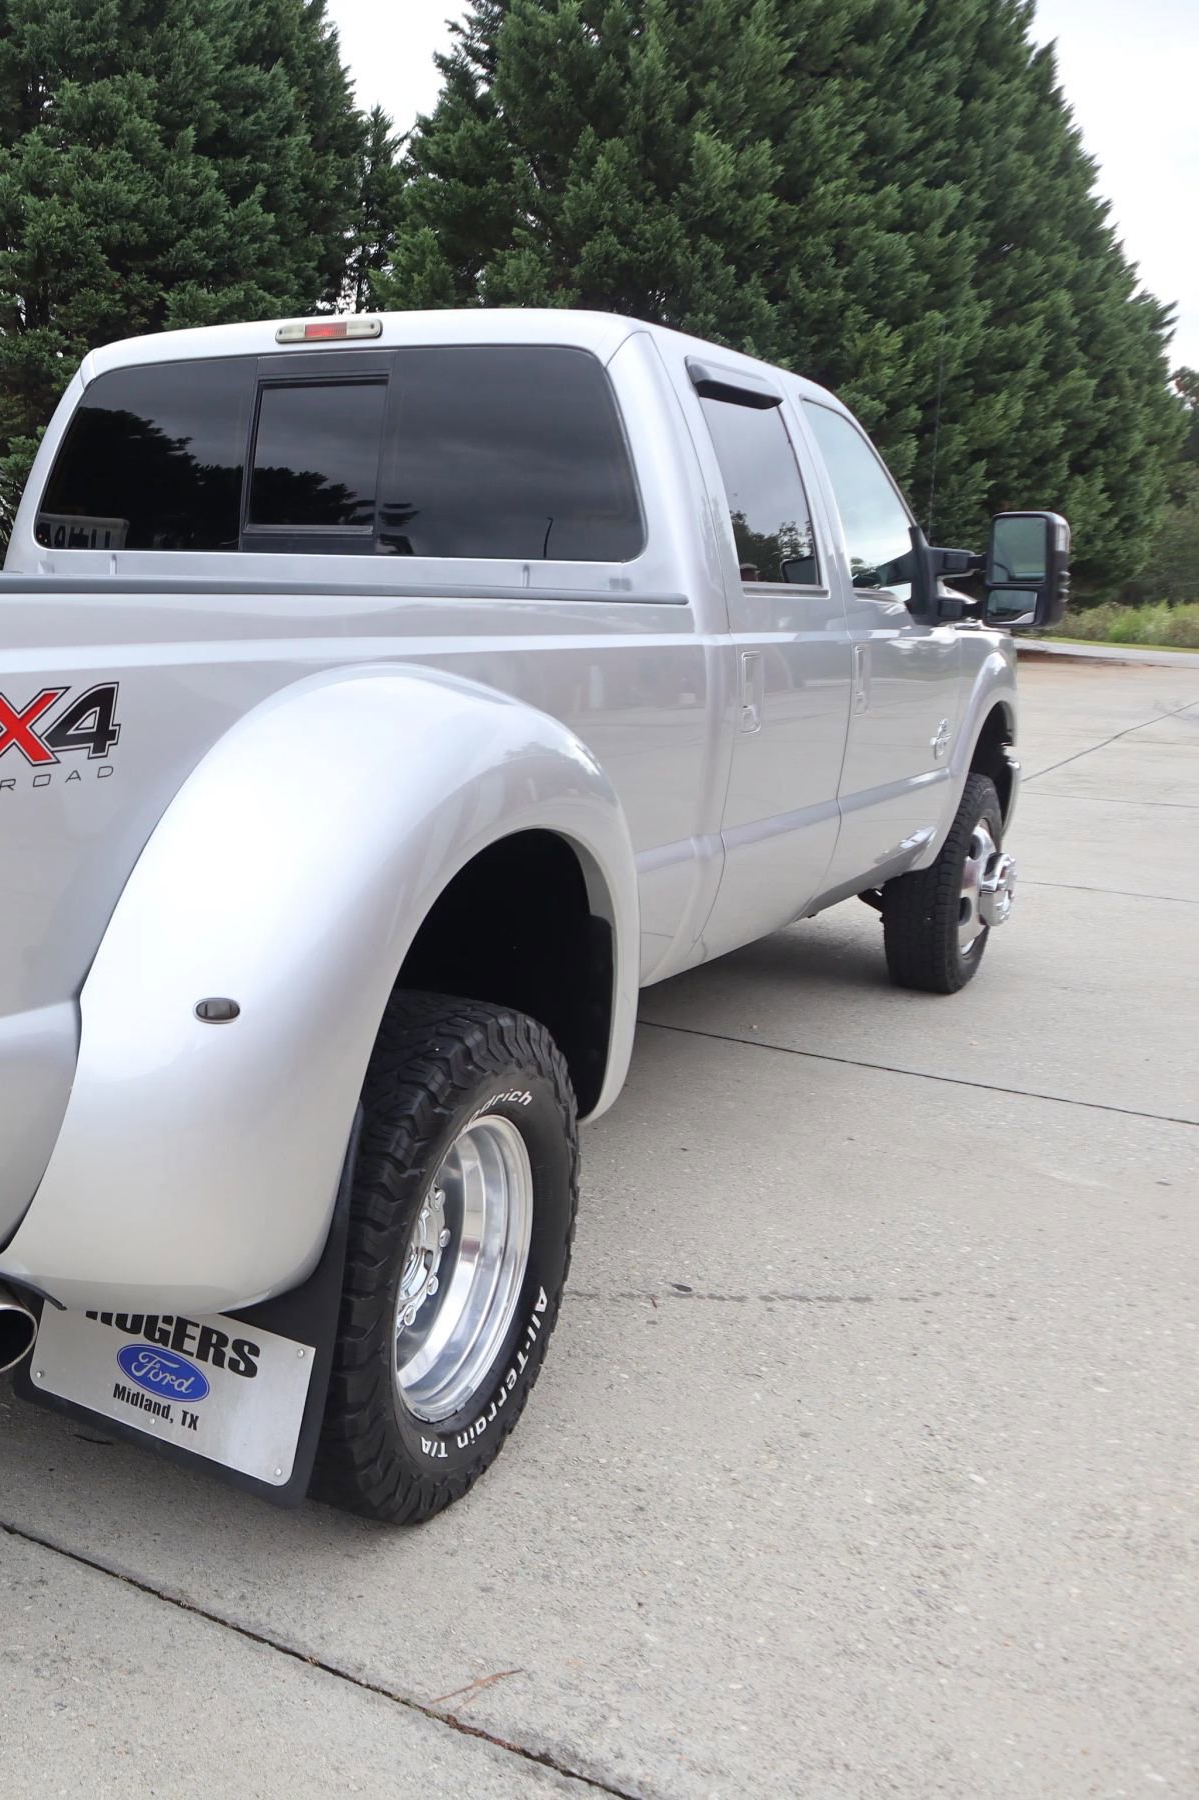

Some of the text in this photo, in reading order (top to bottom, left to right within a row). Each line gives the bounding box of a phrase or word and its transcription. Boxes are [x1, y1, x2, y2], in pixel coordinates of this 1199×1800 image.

[131, 1350, 195, 1394] Ford
[420, 1286, 548, 1458] All-Terrain T/A
[112, 1383, 200, 1431] Midland, TX
